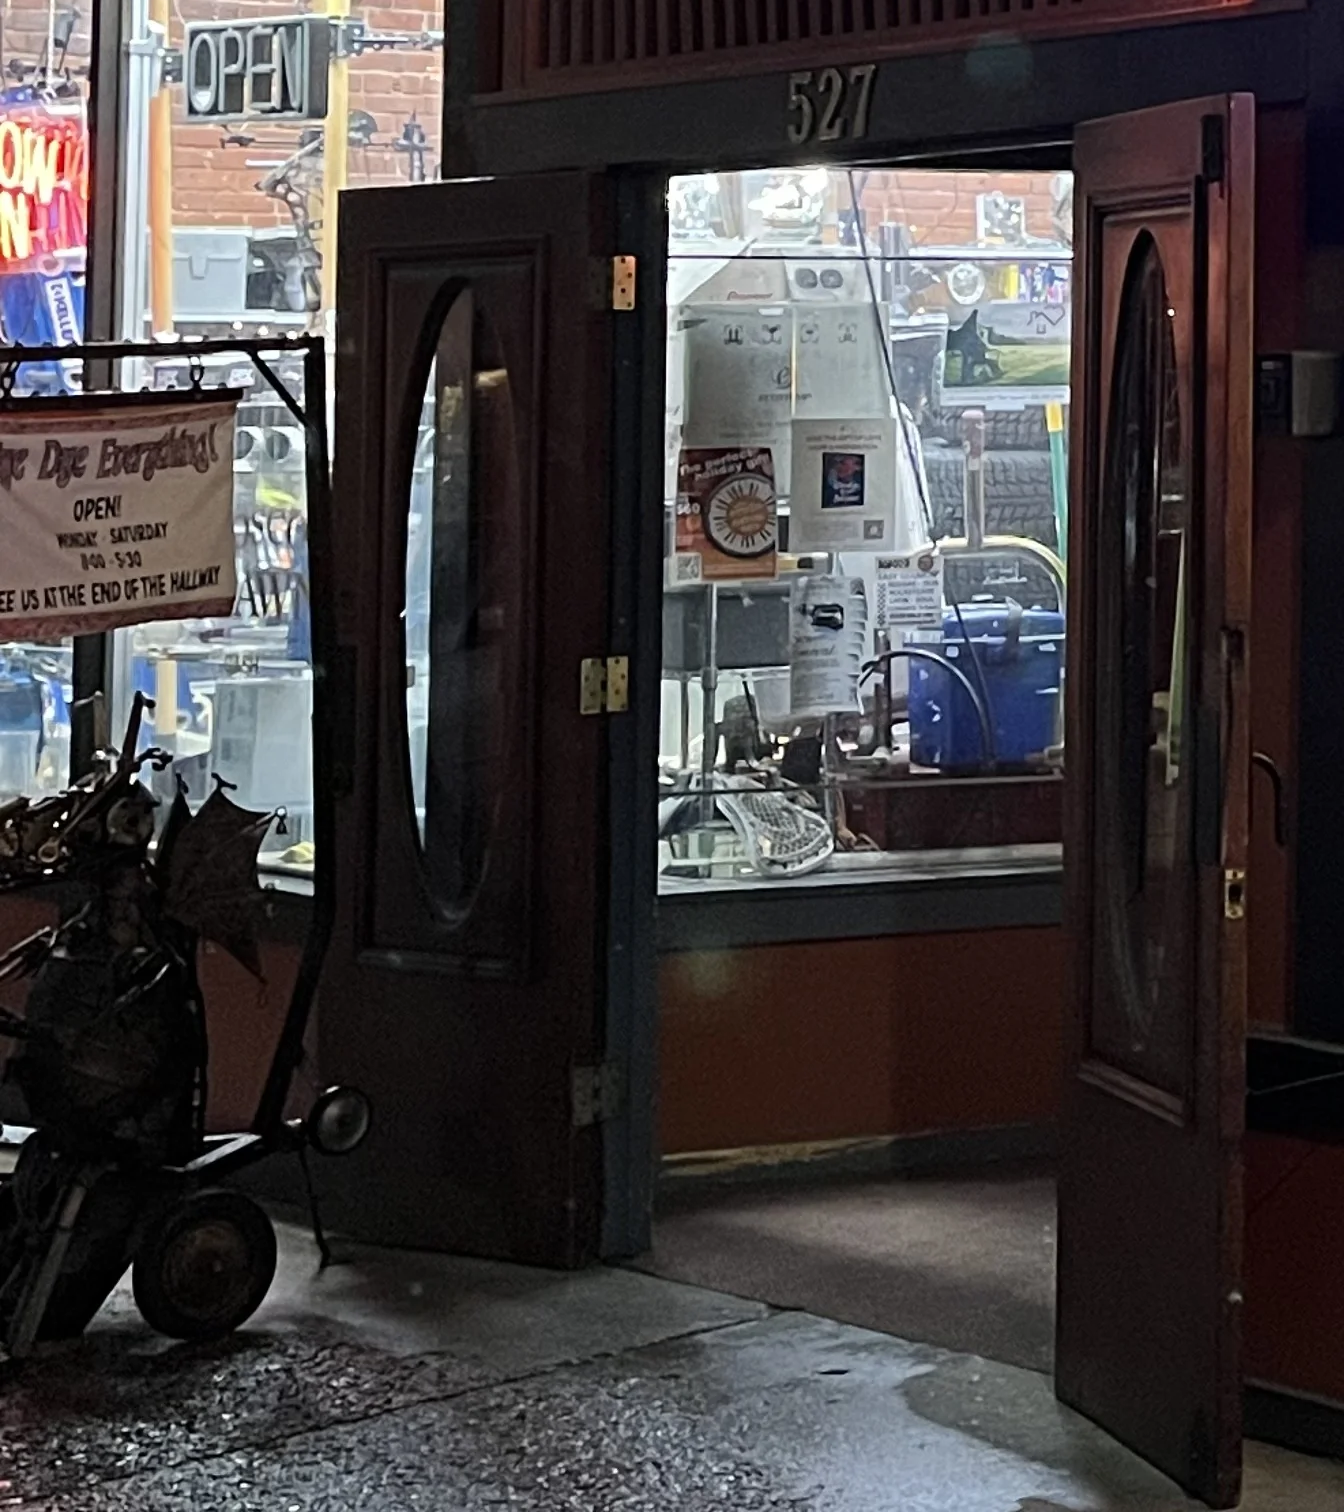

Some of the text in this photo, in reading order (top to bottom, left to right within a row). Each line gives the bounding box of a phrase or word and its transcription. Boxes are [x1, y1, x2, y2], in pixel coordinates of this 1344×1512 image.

[190, 26, 305, 113] OPEN
[787, 64, 876, 144] 527
[37, 439, 90, 489] Dye
[72, 494, 122, 522] OPEN!
[109, 521, 169, 545] SATURDAY
[21, 589, 40, 611] US
[44, 586, 57, 609] AT
[59, 584, 86, 607] THE
[91, 581, 121, 605] END
[123, 579, 141, 600] OF
[140, 574, 166, 599] THE
[169, 565, 221, 594] HALLWAY
